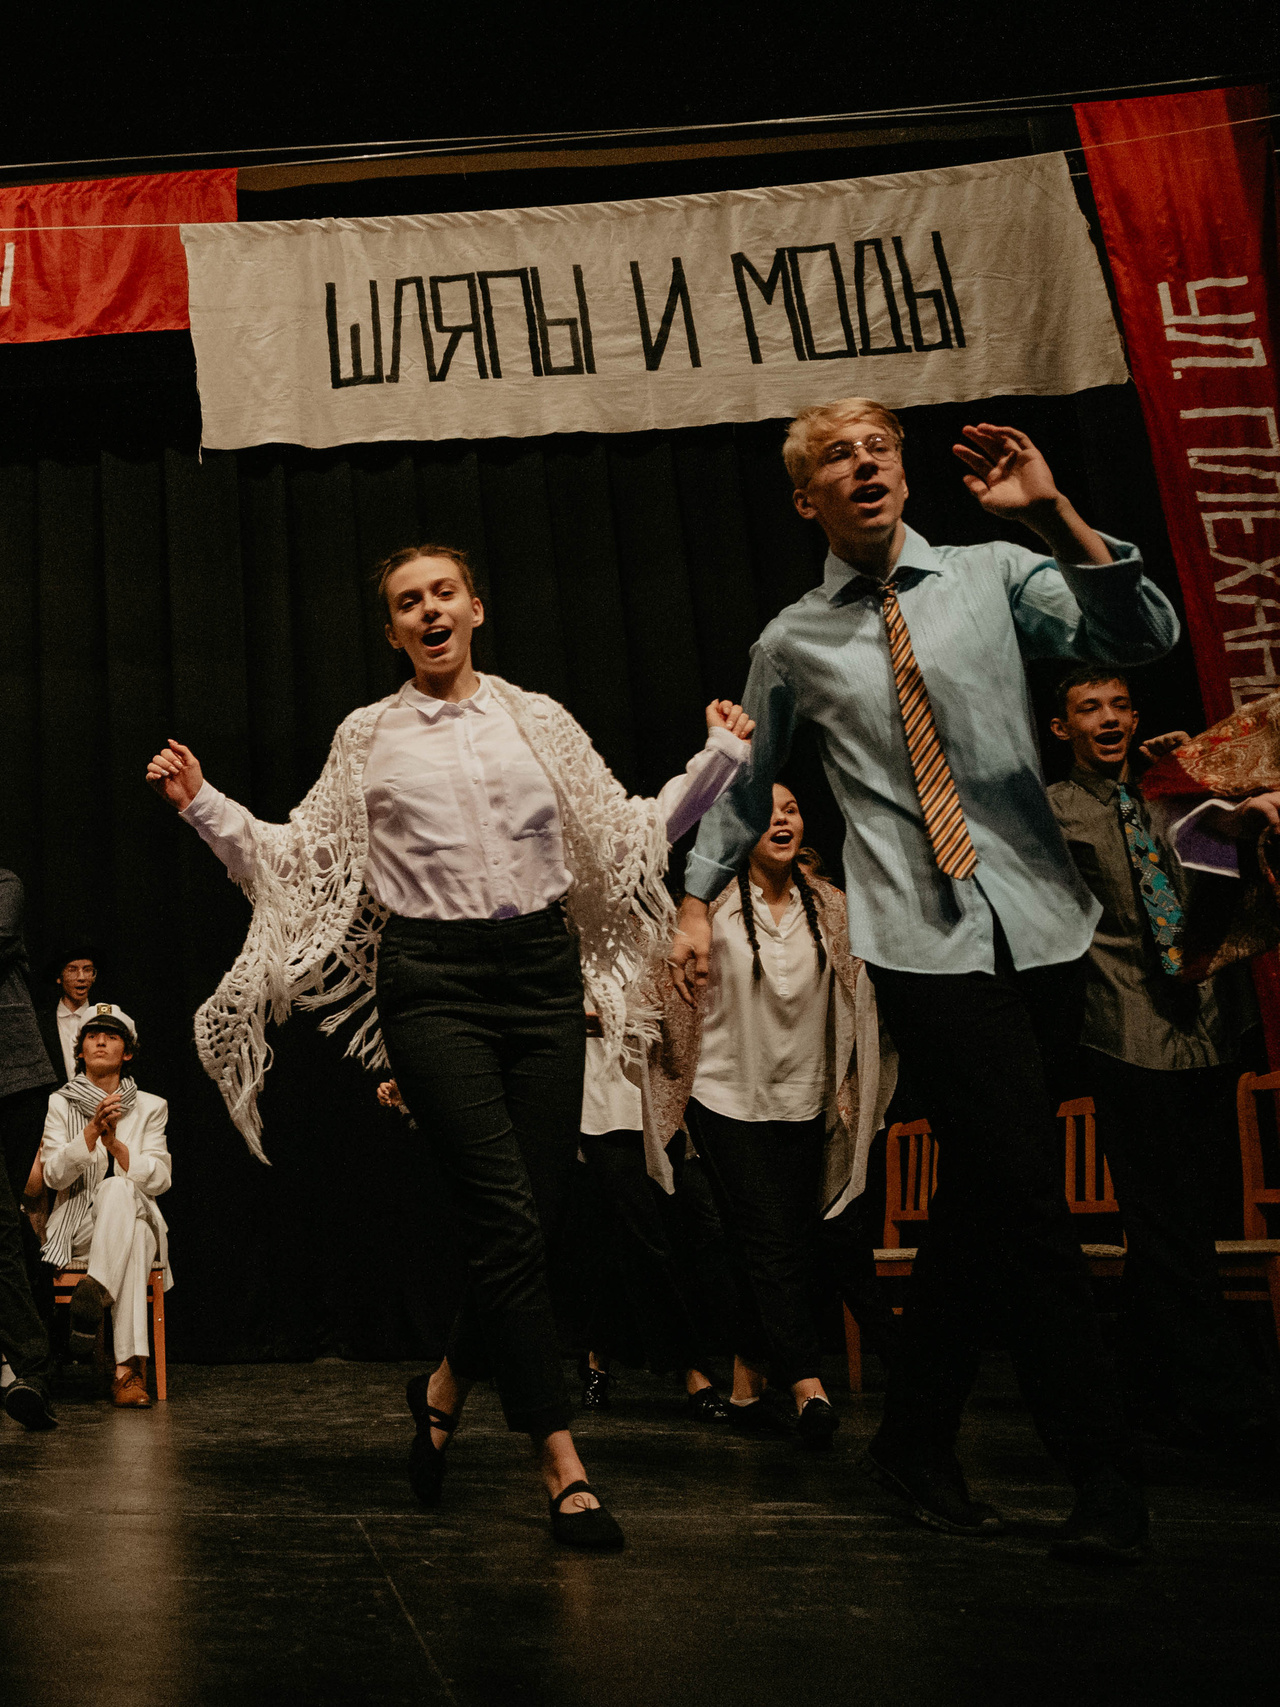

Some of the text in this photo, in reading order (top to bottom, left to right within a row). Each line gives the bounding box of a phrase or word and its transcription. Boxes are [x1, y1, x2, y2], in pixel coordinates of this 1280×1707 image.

[324, 230, 967, 389] ШЛЯПЫ И МОДЫ
[1157, 274, 1269, 380] УЛ.
